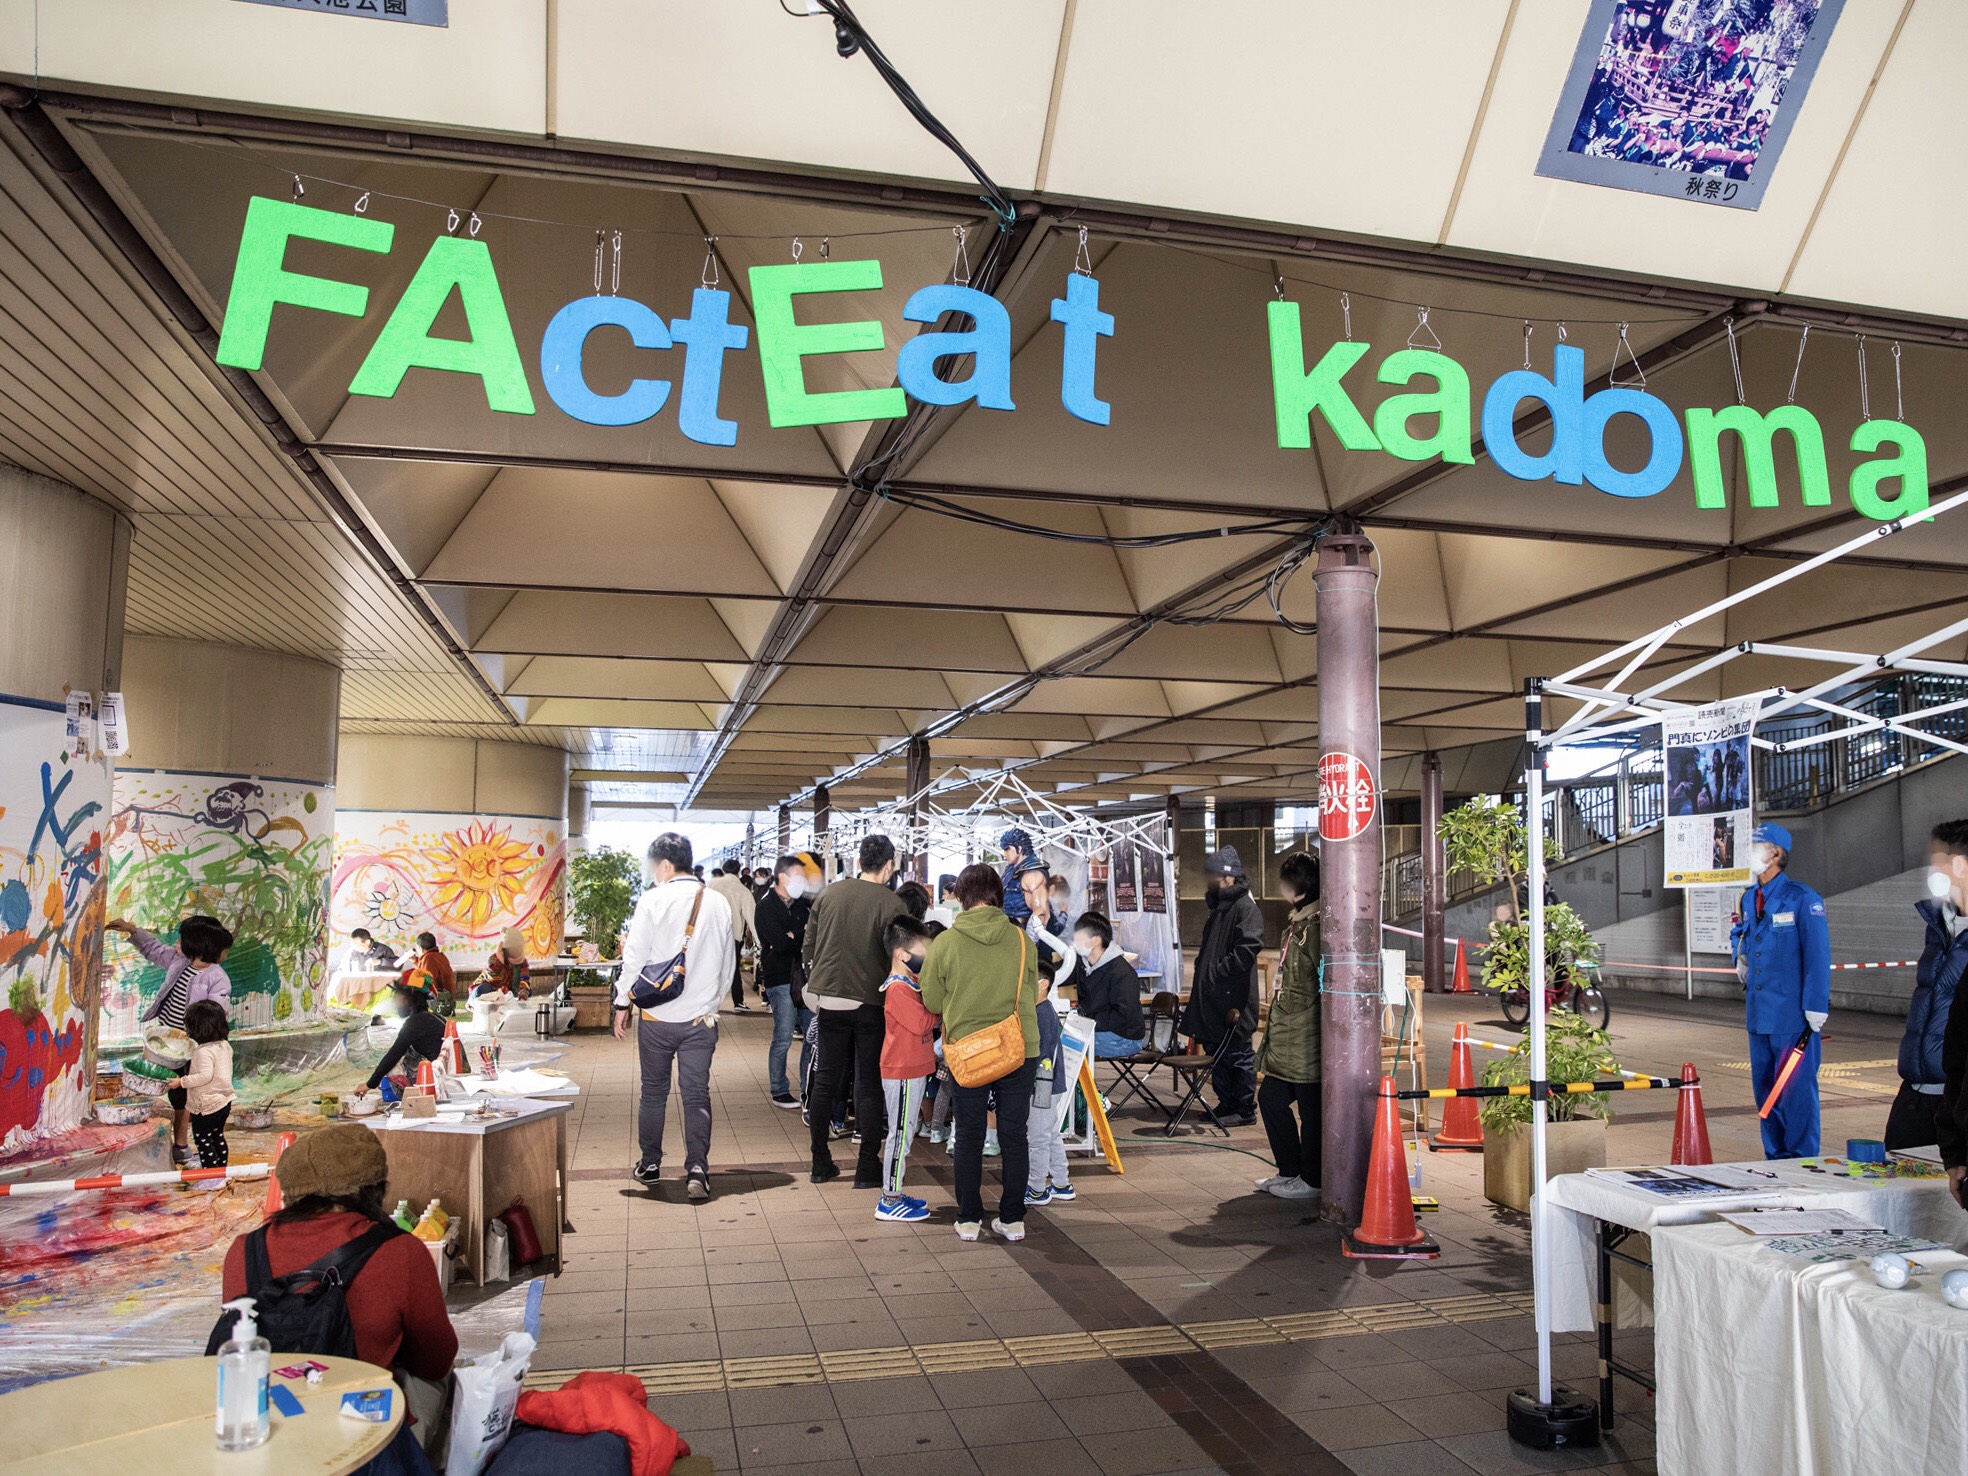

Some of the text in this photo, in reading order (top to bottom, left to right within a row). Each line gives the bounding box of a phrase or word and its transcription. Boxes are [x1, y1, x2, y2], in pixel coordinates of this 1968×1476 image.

[1685, 176, 1739, 202] 秋祭り
[216, 194, 1930, 521] FActEat kadoma
[1667, 720, 1751, 746] 門真にゾンビの集団
[1326, 762, 1361, 775] HYDRAT
